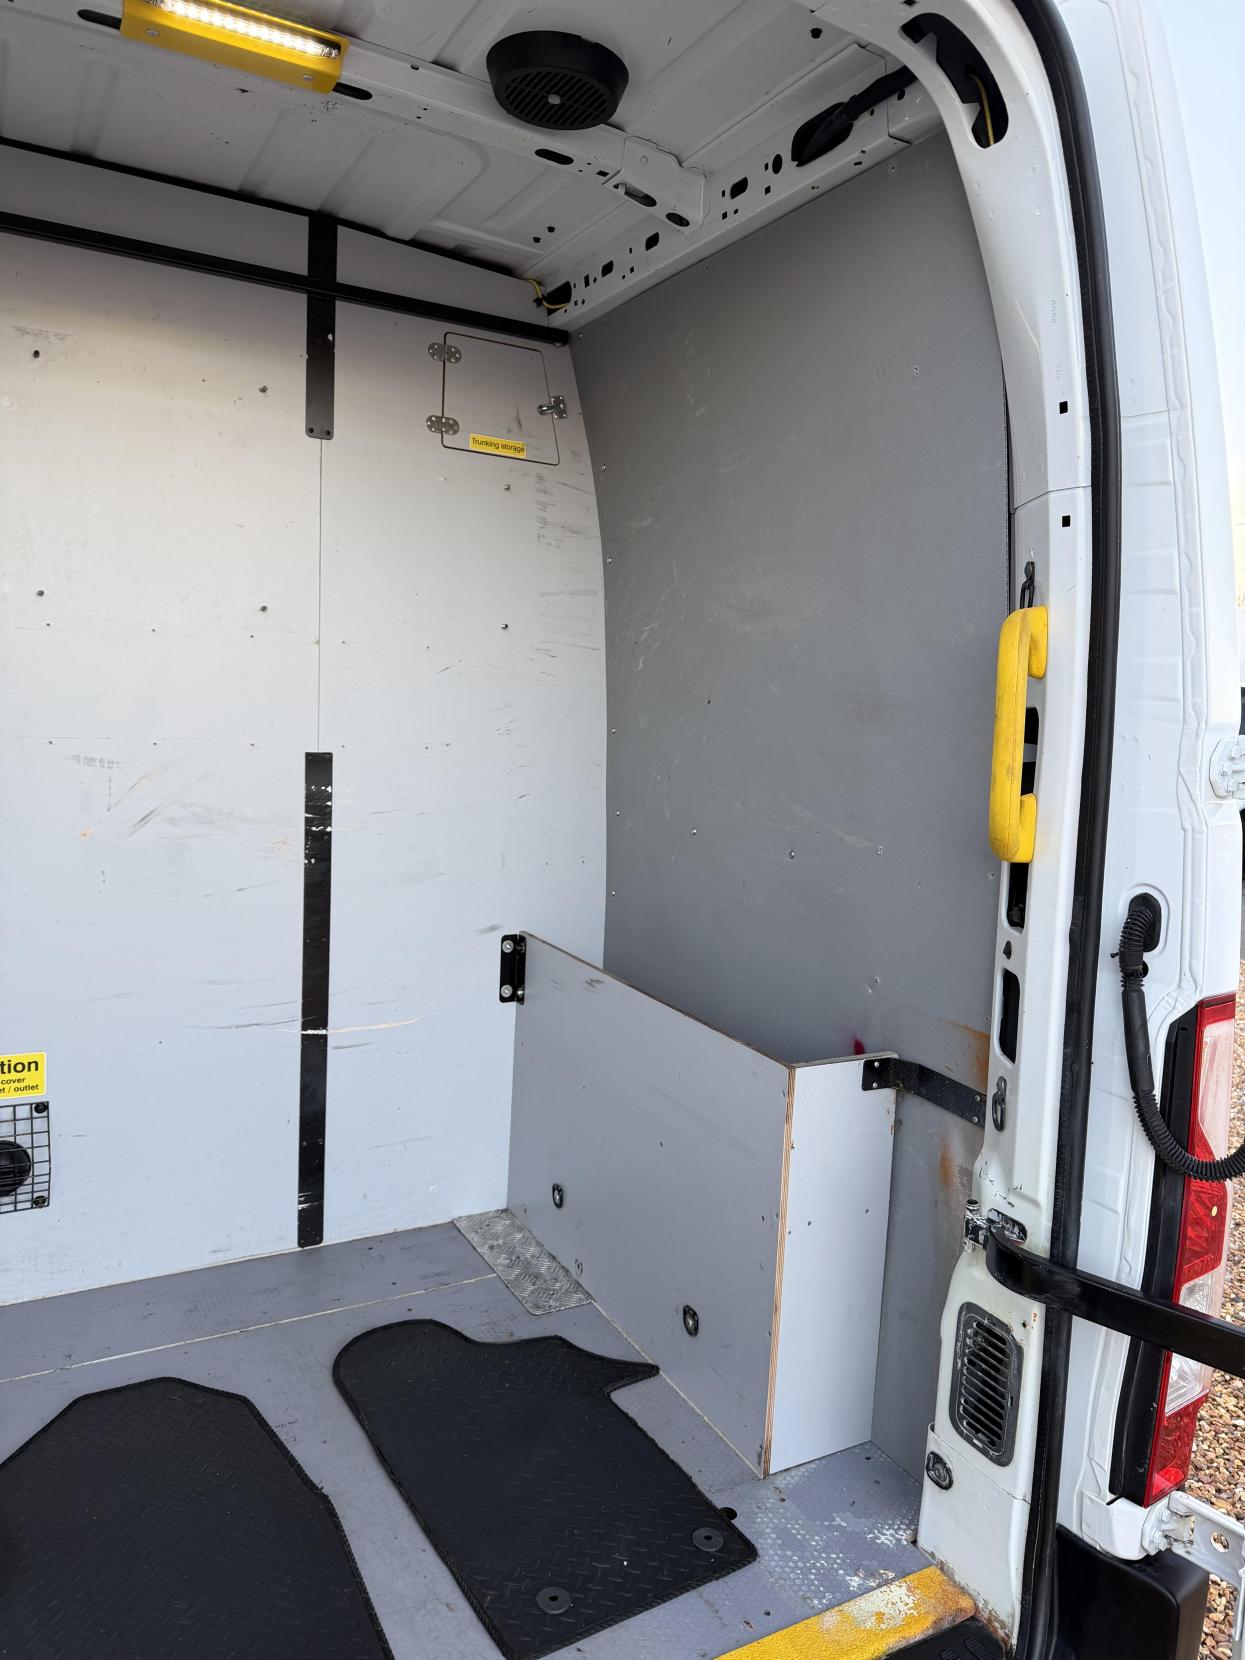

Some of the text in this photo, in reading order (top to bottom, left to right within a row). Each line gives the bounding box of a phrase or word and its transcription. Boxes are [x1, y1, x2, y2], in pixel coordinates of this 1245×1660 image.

[472, 437, 525, 453] Trunking storage
[13, 1084, 39, 1092] outlet
